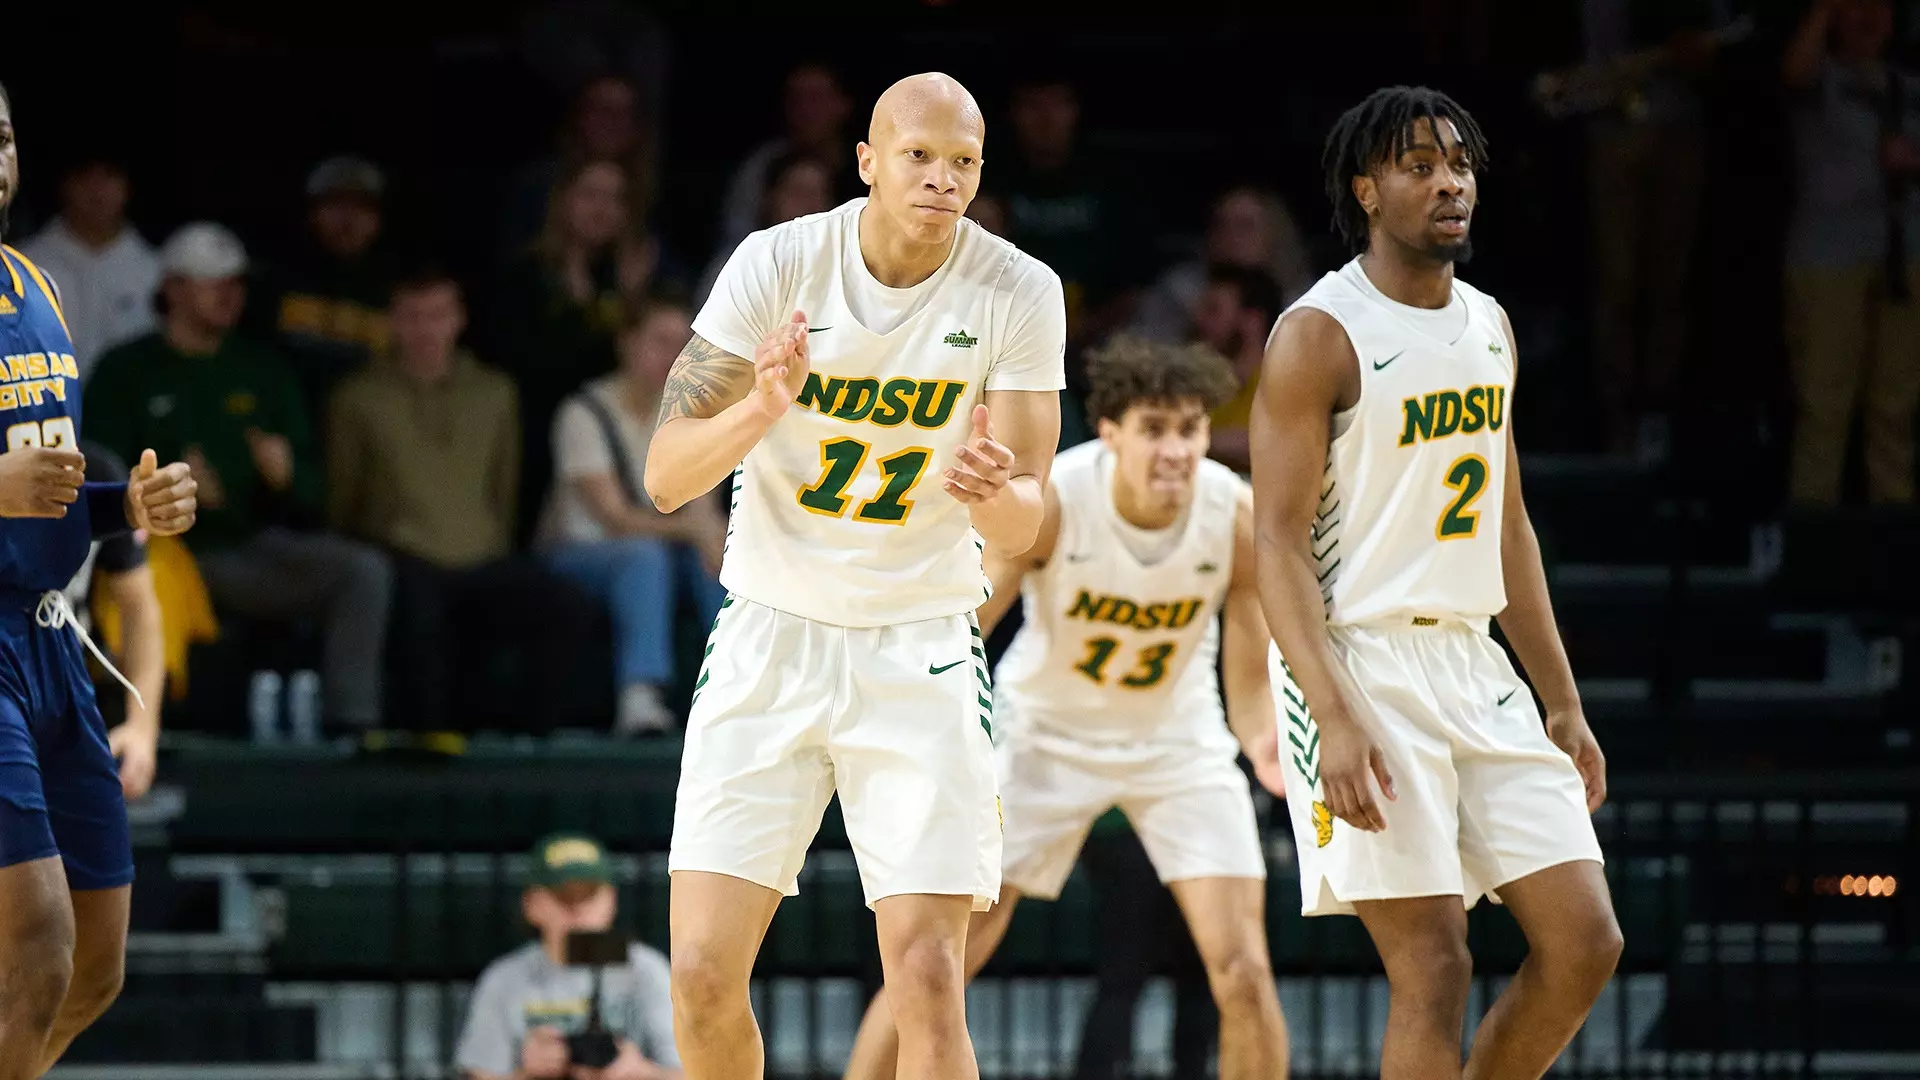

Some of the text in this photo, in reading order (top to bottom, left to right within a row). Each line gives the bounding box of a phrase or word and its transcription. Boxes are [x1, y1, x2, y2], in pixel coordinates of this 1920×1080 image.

[0, 377, 66, 411] CITY
[793, 370, 968, 430] NDSU
[1397, 384, 1506, 449] NDSU
[796, 436, 934, 526] 11
[1435, 453, 1490, 541] 2
[1066, 588, 1204, 630] NDSU
[1073, 632, 1178, 692] 13
